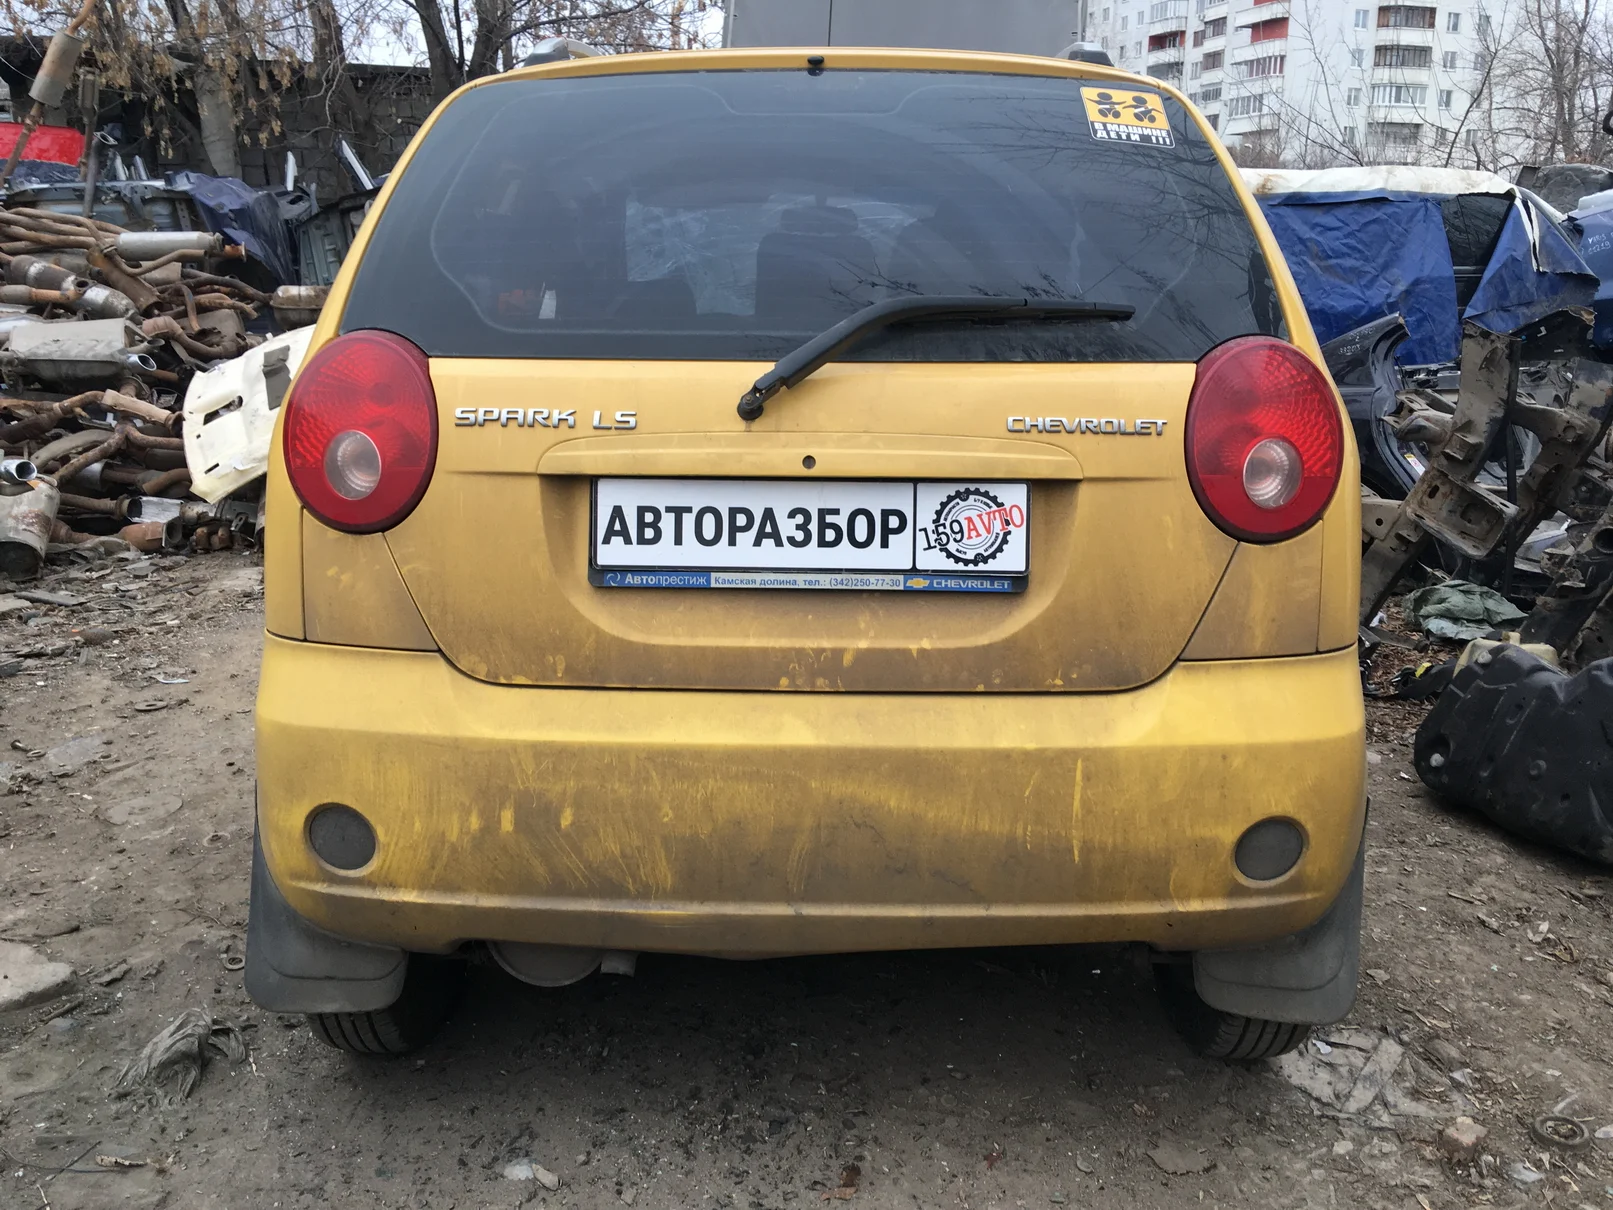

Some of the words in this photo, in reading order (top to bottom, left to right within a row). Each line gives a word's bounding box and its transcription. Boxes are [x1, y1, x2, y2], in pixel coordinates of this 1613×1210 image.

[1094, 122, 1105, 130] В
[1106, 123, 1169, 138] МАШИНЕ
[1096, 130, 1141, 142] ДЕТИ
[454, 407, 576, 429] SPARK
[592, 410, 637, 430] LS
[1006, 416, 1168, 436] CHEVROLET
[601, 505, 908, 549] АВТОРАЗБОР
[624, 573, 707, 586] Автопрестиж
[714, 576, 757, 586] Камская
[759, 578, 800, 588] долина,
[803, 579, 826, 587] тел.:
[829, 577, 901, 588] (342)250-77-30
[933, 579, 1011, 589] CHEVROLET
